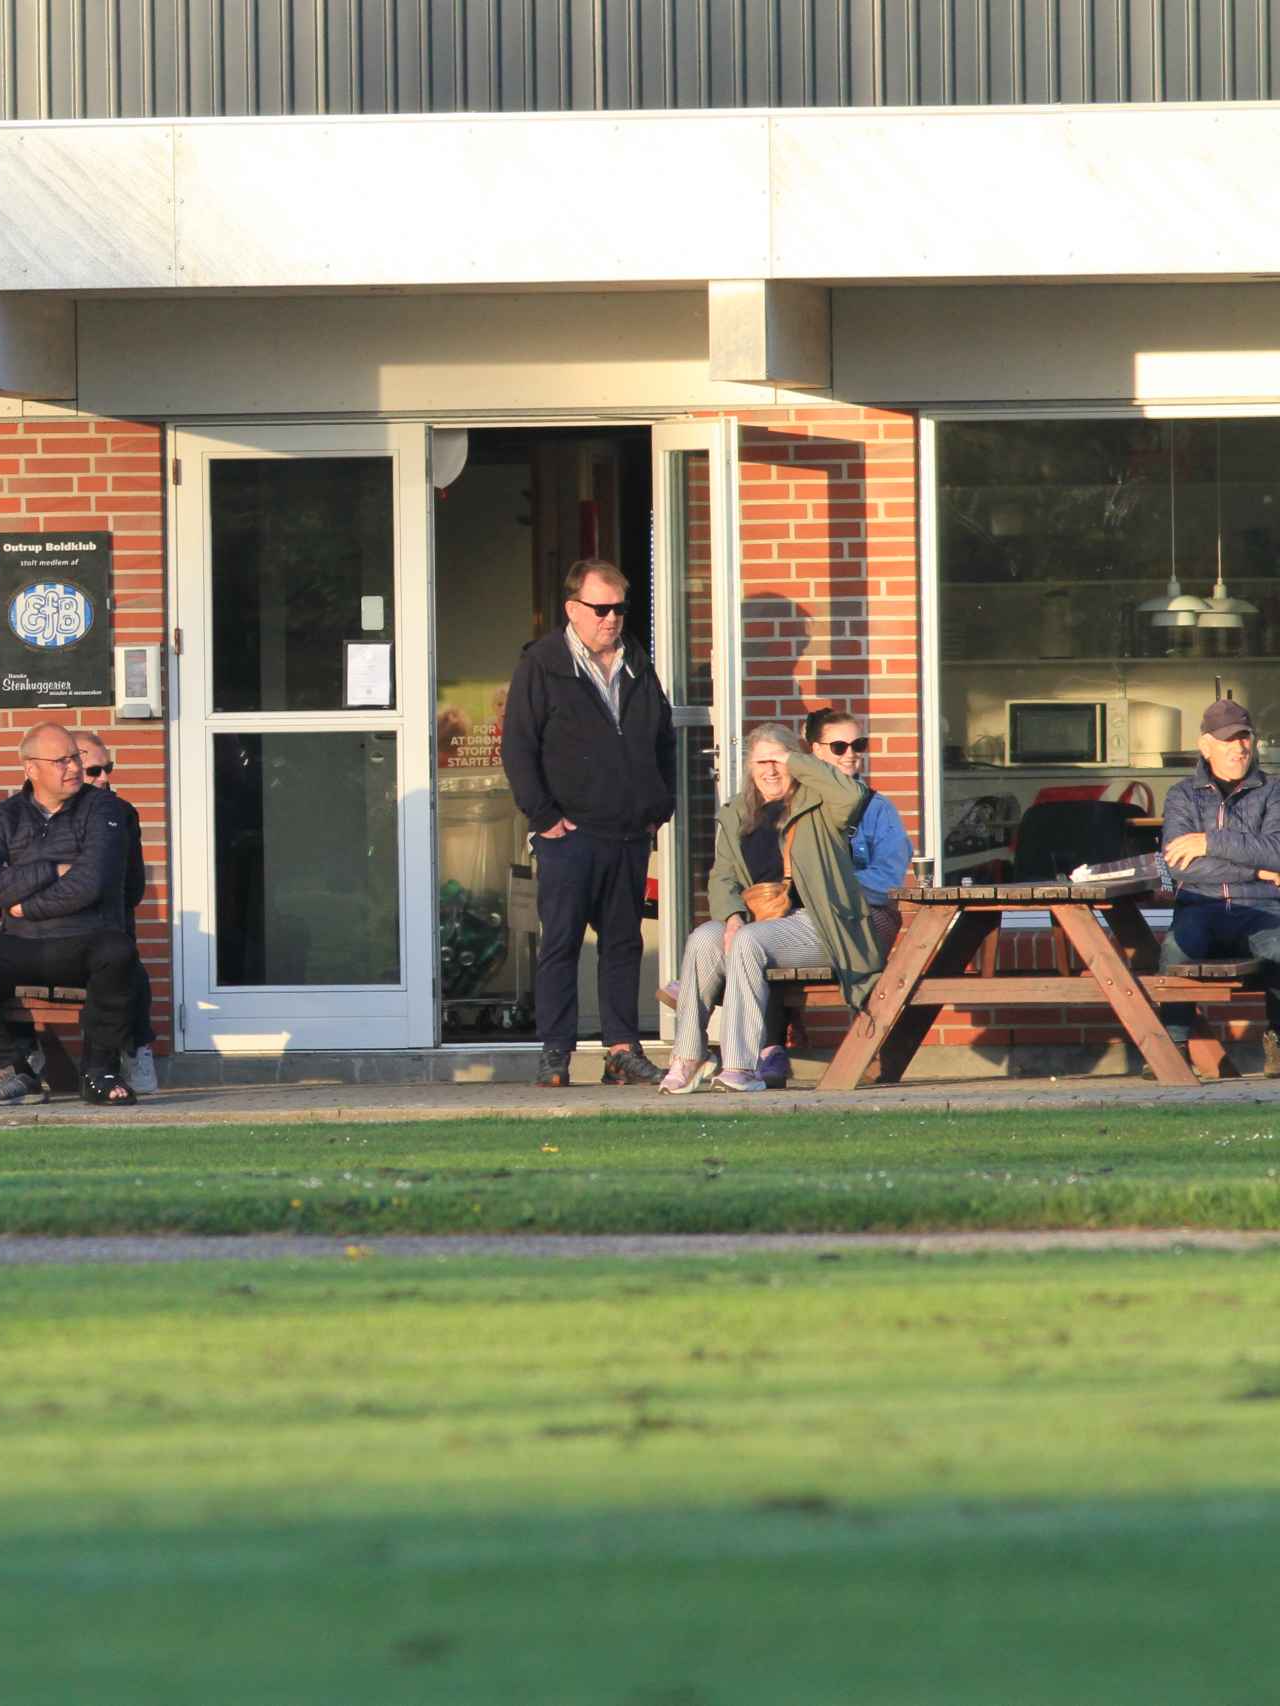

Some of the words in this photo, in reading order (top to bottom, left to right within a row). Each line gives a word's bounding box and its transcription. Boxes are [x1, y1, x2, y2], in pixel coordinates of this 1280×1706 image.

[2, 543, 43, 554] Outrup
[45, 541, 97, 551] Boldklub
[472, 725, 497, 735] FOR
[450, 736, 465, 745] AT
[456, 746, 493, 757] STORT
[447, 757, 490, 767] STARTE
